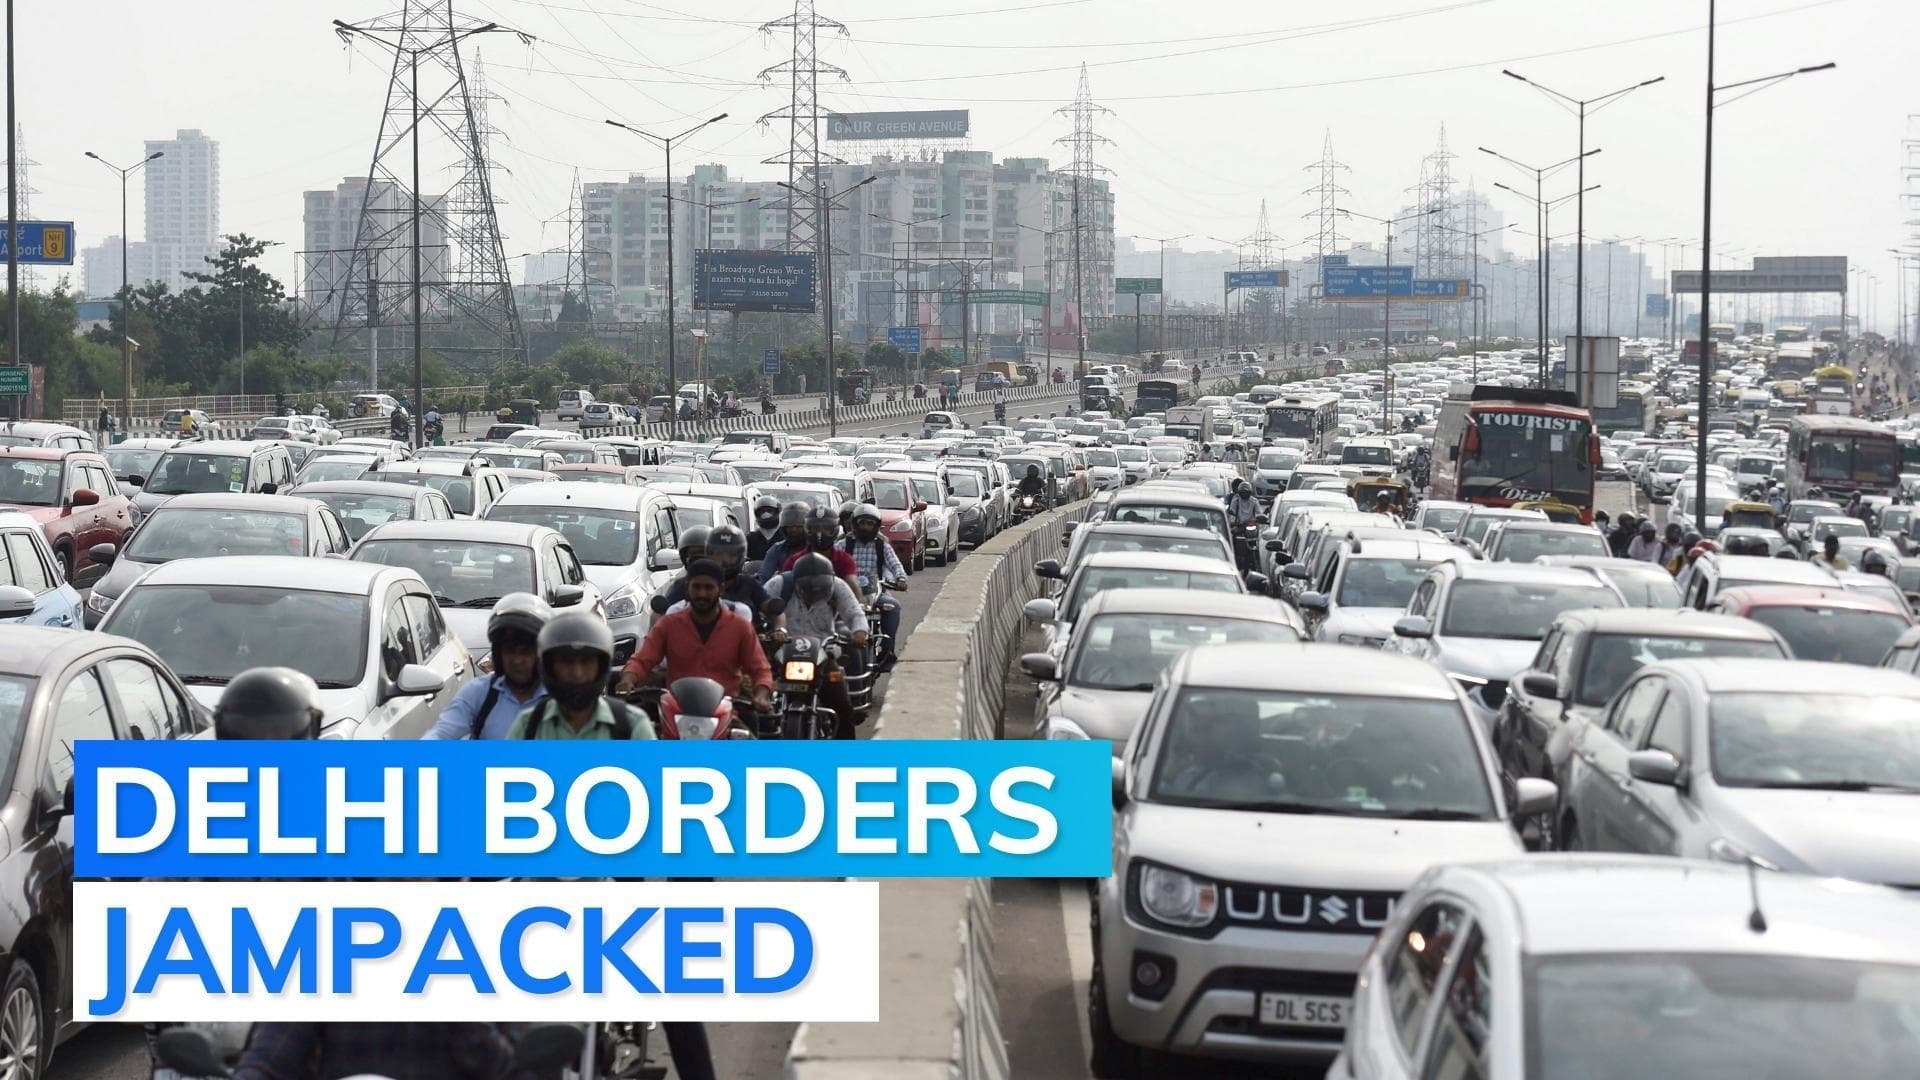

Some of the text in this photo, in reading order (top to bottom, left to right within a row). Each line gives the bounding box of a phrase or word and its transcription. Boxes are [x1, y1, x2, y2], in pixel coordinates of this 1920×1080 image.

[834, 120, 965, 133] GAUR GREEN AVENUE
[51, 242, 58, 253] 9
[719, 264, 755, 276] Broadway
[758, 264, 783, 274] Greno
[1479, 413, 1581, 432] TOURIST
[1276, 999, 1298, 1021] DL
